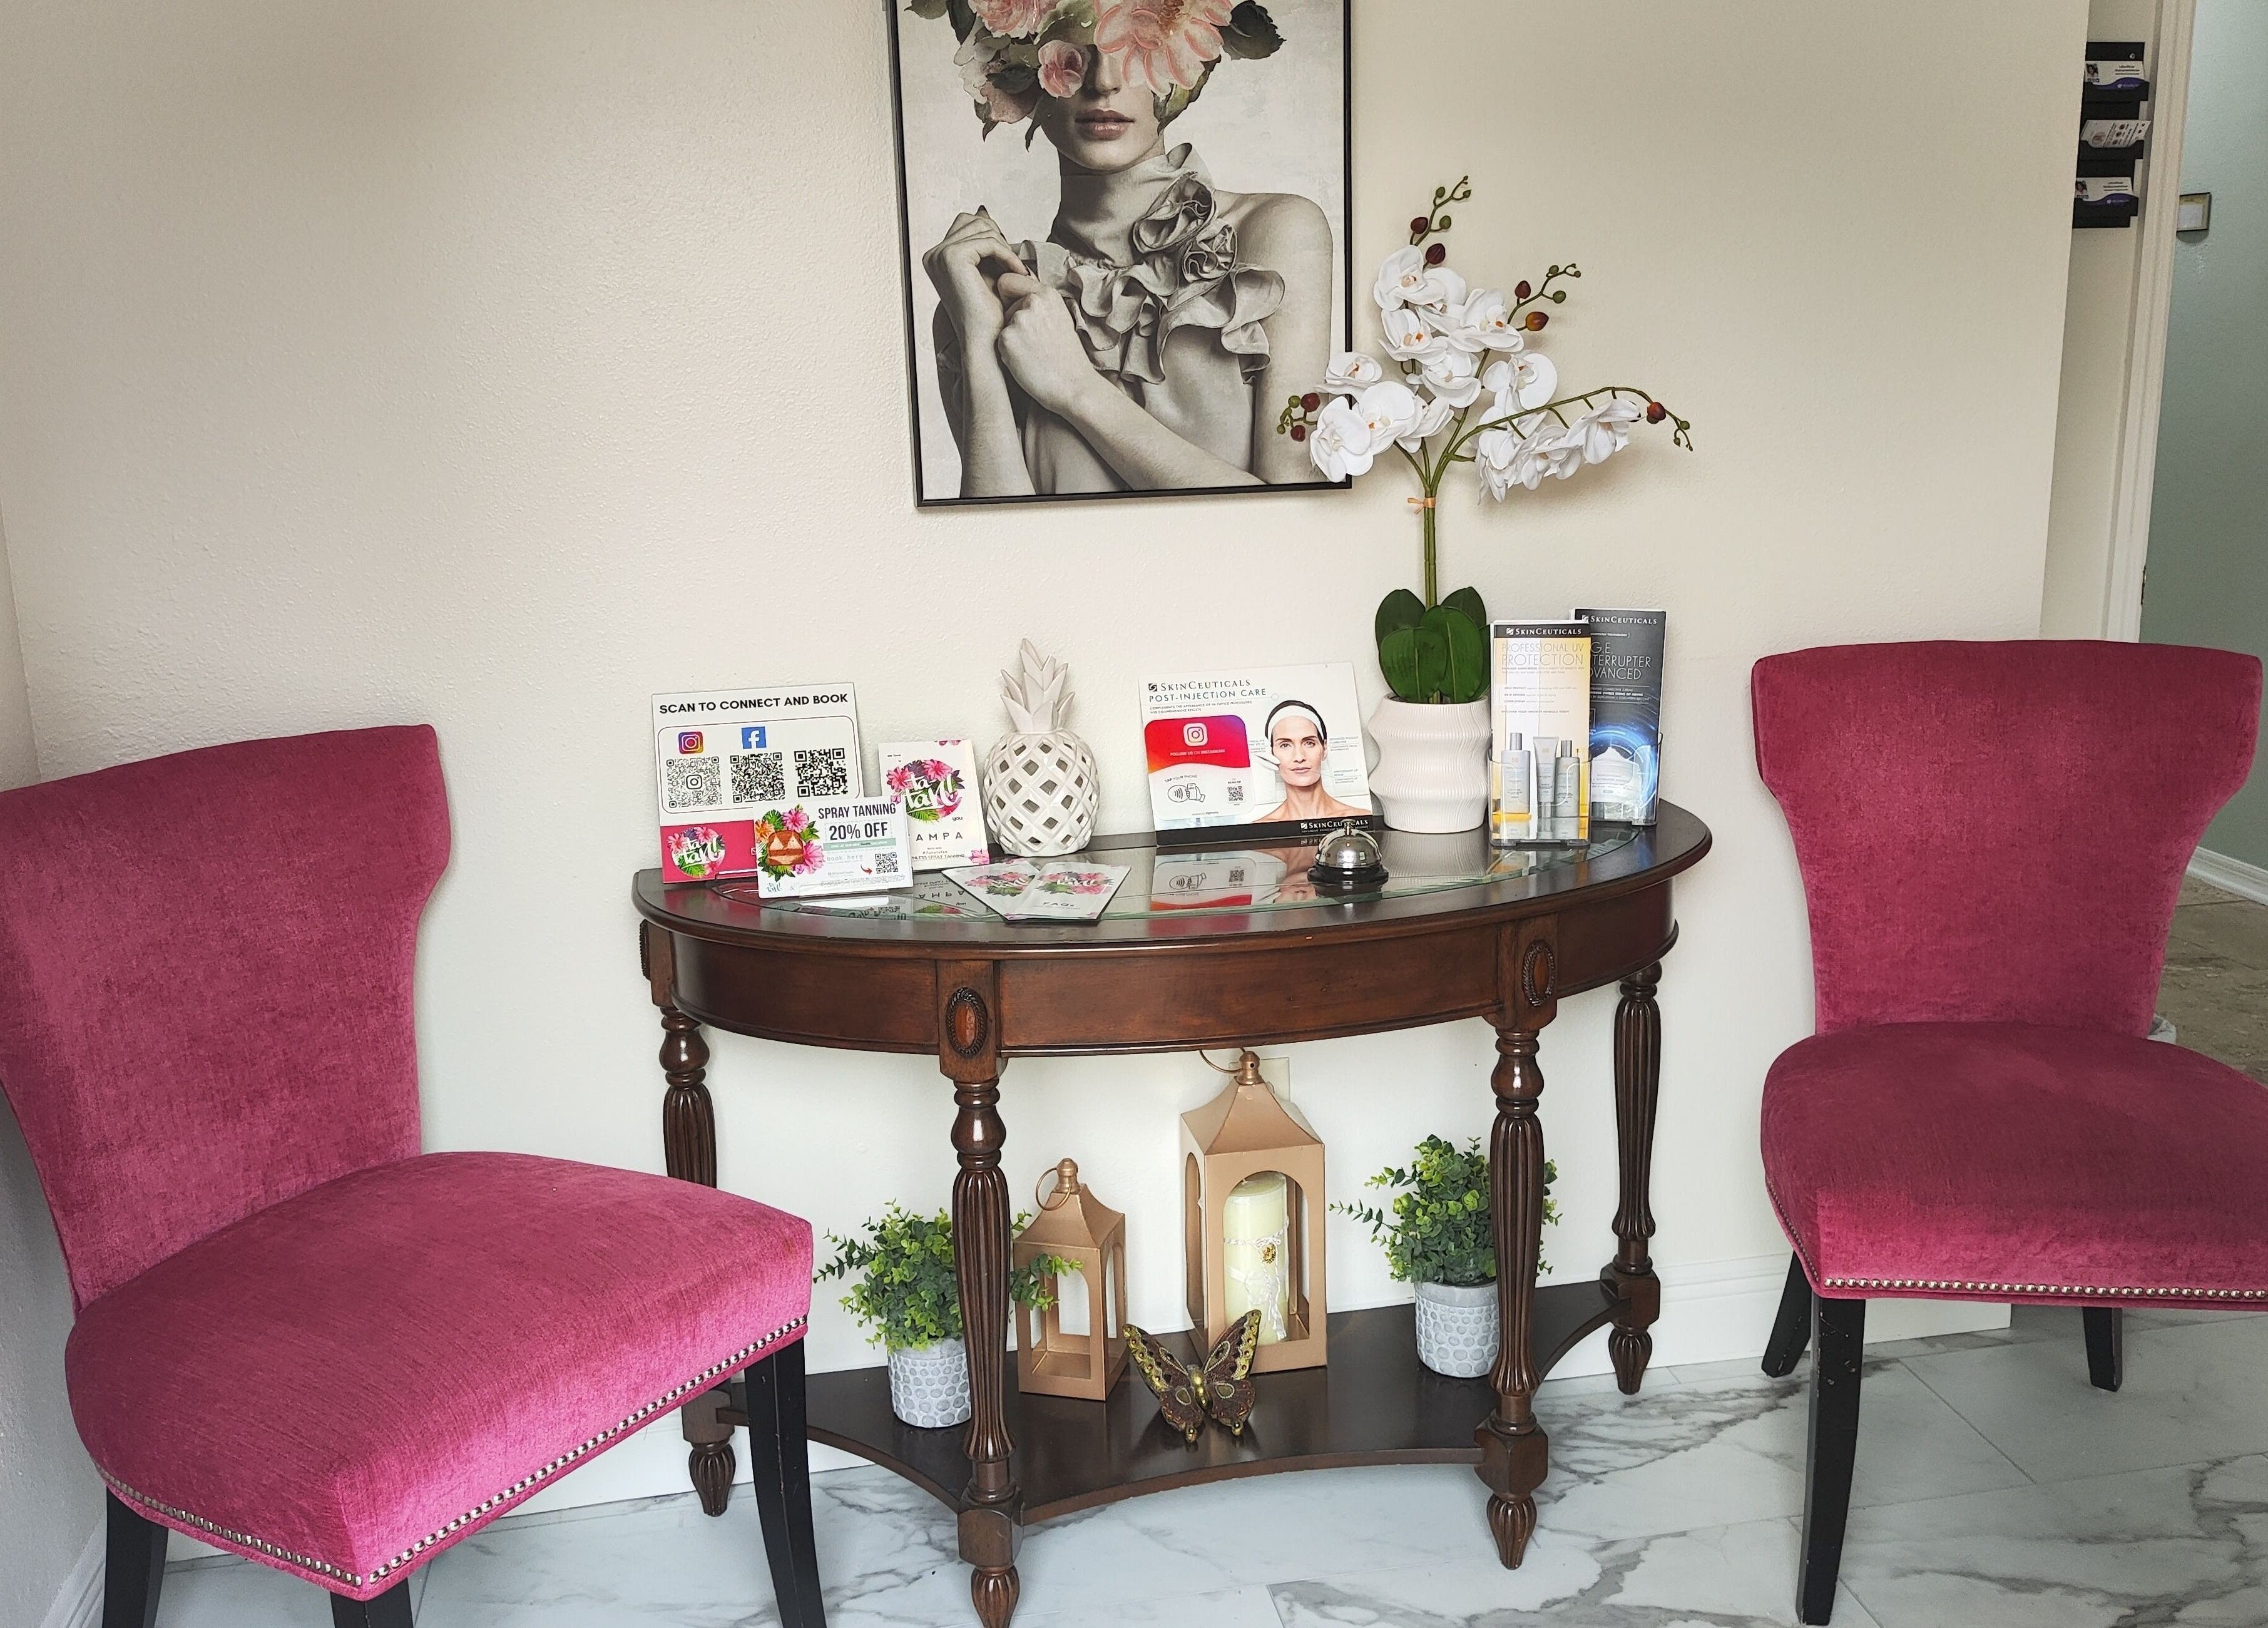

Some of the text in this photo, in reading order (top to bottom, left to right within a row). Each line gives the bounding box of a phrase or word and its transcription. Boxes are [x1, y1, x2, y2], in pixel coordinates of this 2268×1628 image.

[1590, 615, 1657, 625] SKINCEUTICALS
[1502, 643, 1585, 652] PROFESSIONAL UV
[1502, 653, 1584, 666] PROTECTION
[1590, 655, 1652, 668] TERRUPTER
[1161, 678, 1251, 692] SKINCEUTICALS
[1149, 689, 1267, 703] POST-INJECTION CARE
[659, 693, 849, 714] SCAN TO CONNECT AND BOOK
[818, 802, 896, 819] SPRAY TANNING
[1309, 819, 1369, 829] SKINCEUTCALS
[829, 821, 888, 841] 20% OFF
[908, 831, 963, 842] AMPA
